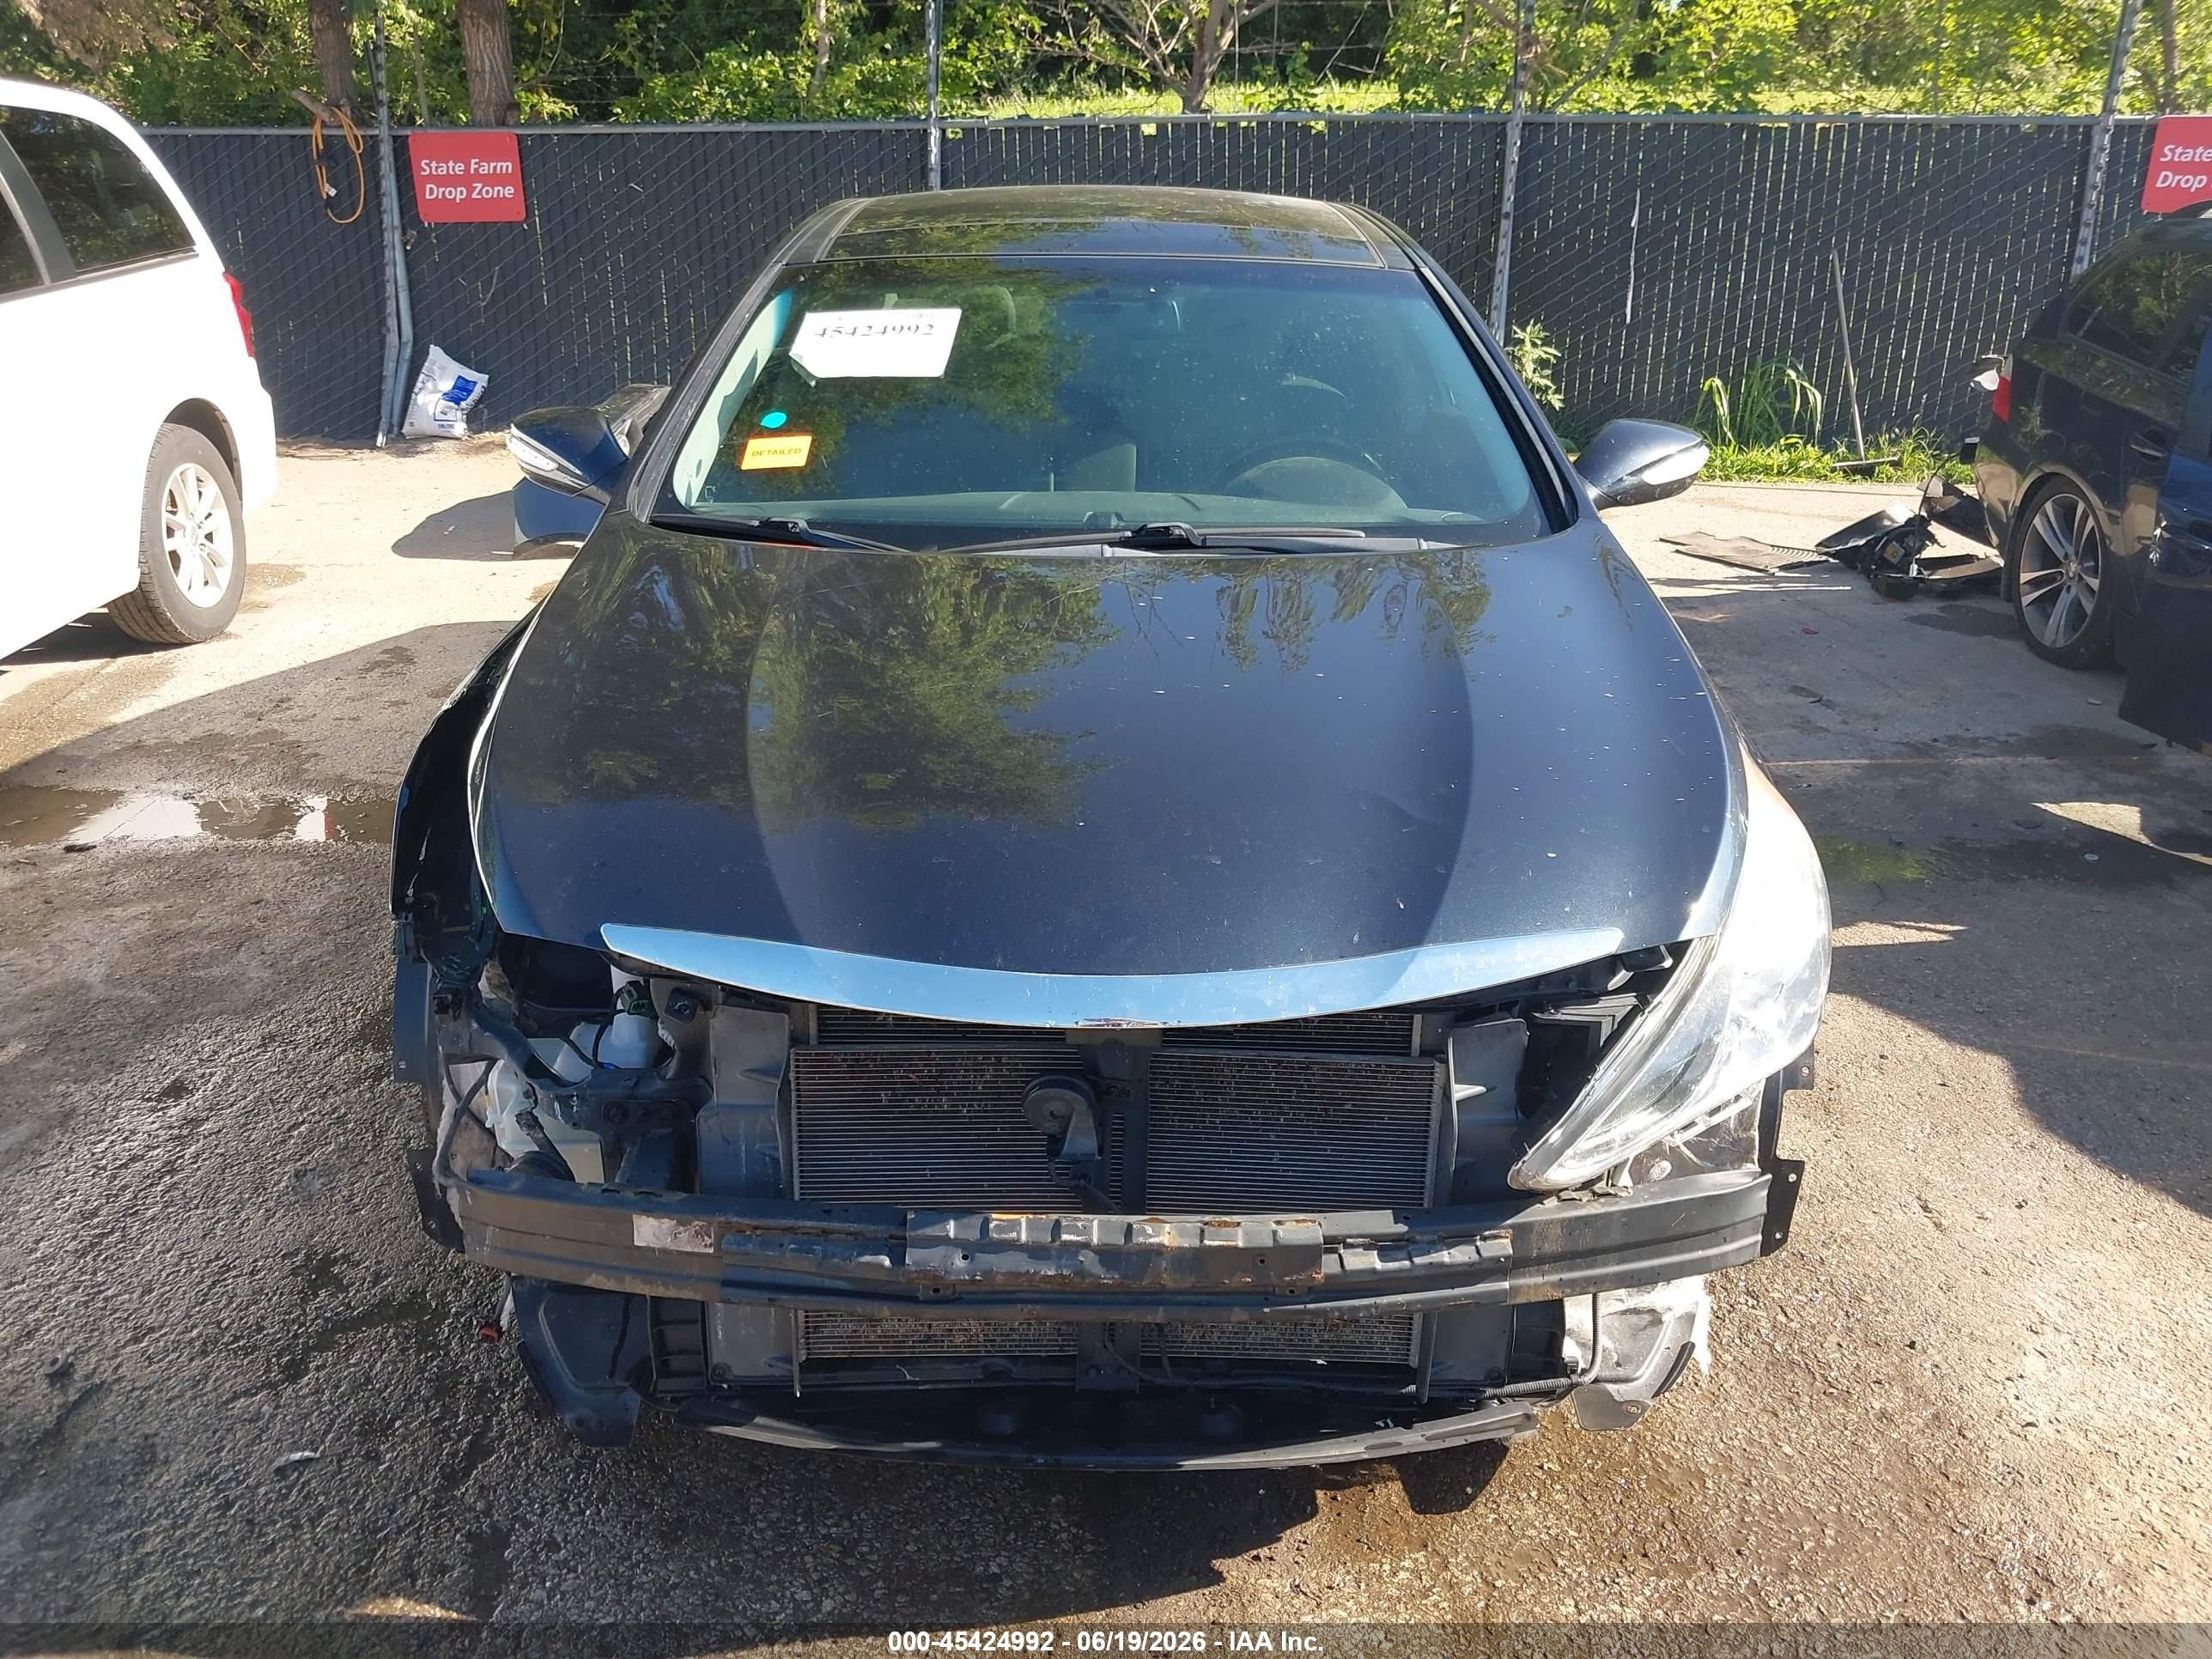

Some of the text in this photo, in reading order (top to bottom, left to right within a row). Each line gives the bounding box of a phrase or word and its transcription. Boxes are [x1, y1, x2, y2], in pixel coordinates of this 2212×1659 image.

[2160, 144, 2212, 161] State
[420, 159, 513, 175] State Farm
[2155, 171, 2208, 192] Drop
[425, 183, 515, 203] Drop Zone
[814, 324, 935, 338] 45424992
[751, 448, 802, 457] DETAILED
